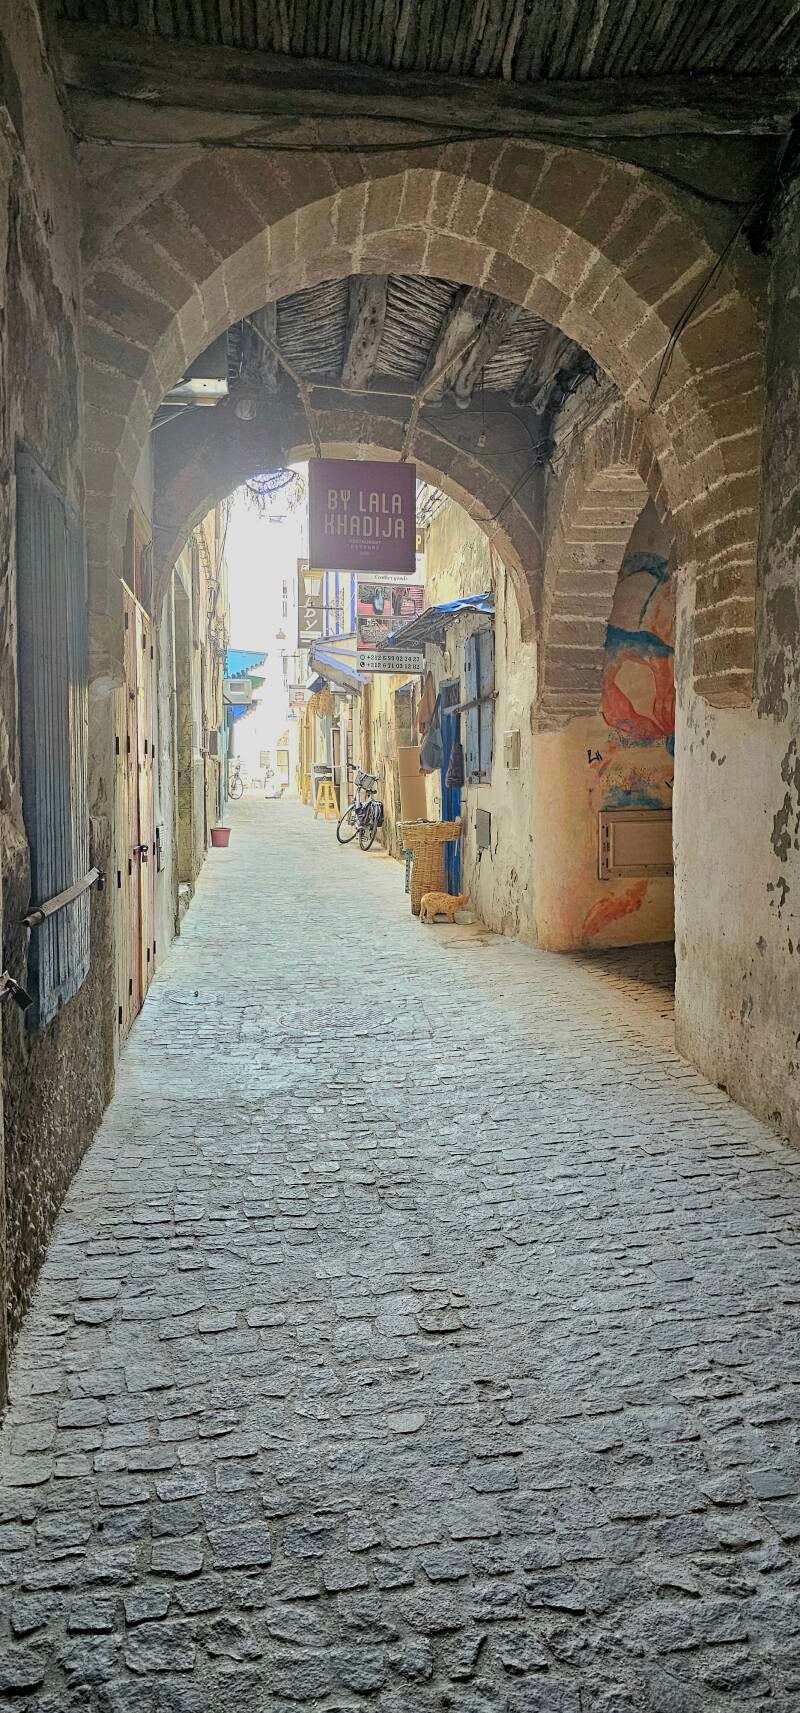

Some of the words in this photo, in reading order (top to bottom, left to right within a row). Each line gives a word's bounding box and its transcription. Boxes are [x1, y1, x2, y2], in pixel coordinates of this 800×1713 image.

[327, 489, 351, 511] BY
[359, 490, 402, 514] LALA
[324, 513, 405, 539] KHADIJA
